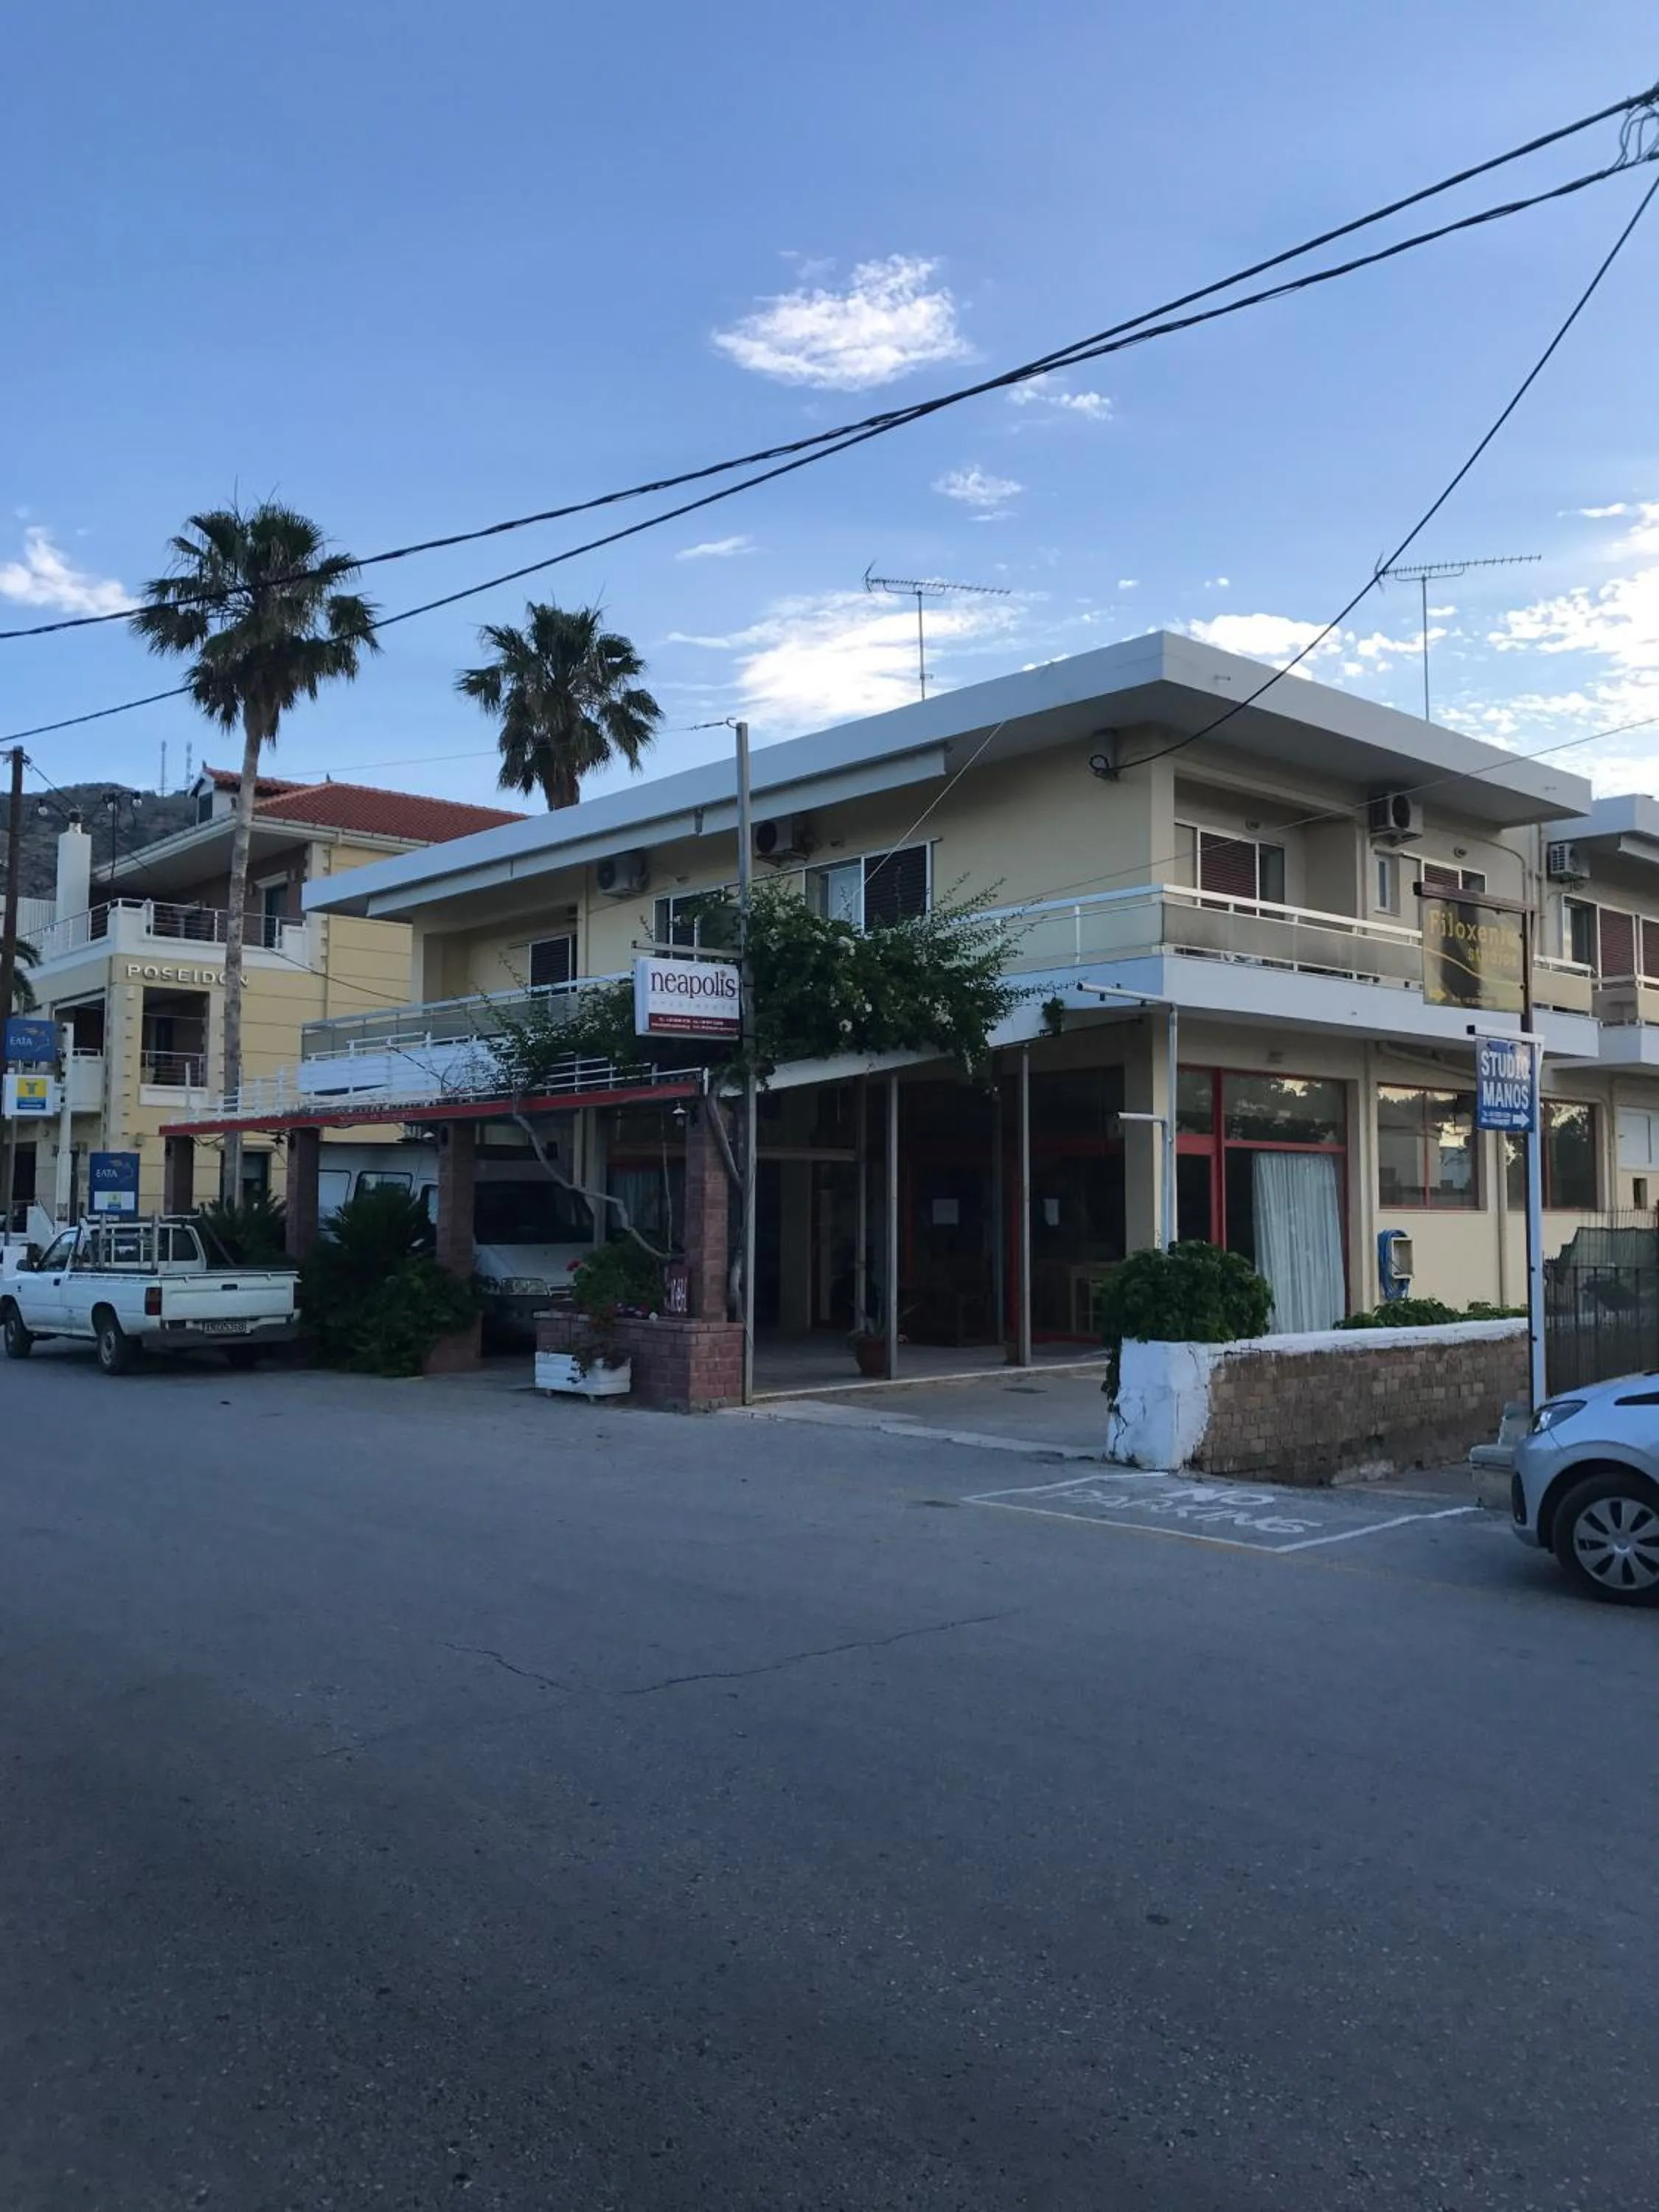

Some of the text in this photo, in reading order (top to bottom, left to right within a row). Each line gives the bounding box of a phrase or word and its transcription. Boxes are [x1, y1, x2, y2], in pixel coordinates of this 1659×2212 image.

[651, 970, 736, 998] neapolis
[1481, 1050, 1530, 1080] STUDIO
[1483, 1081, 1529, 1109] MANOS
[1158, 1487, 1274, 1506] NO
[1039, 1489, 1322, 1533] PARKING
